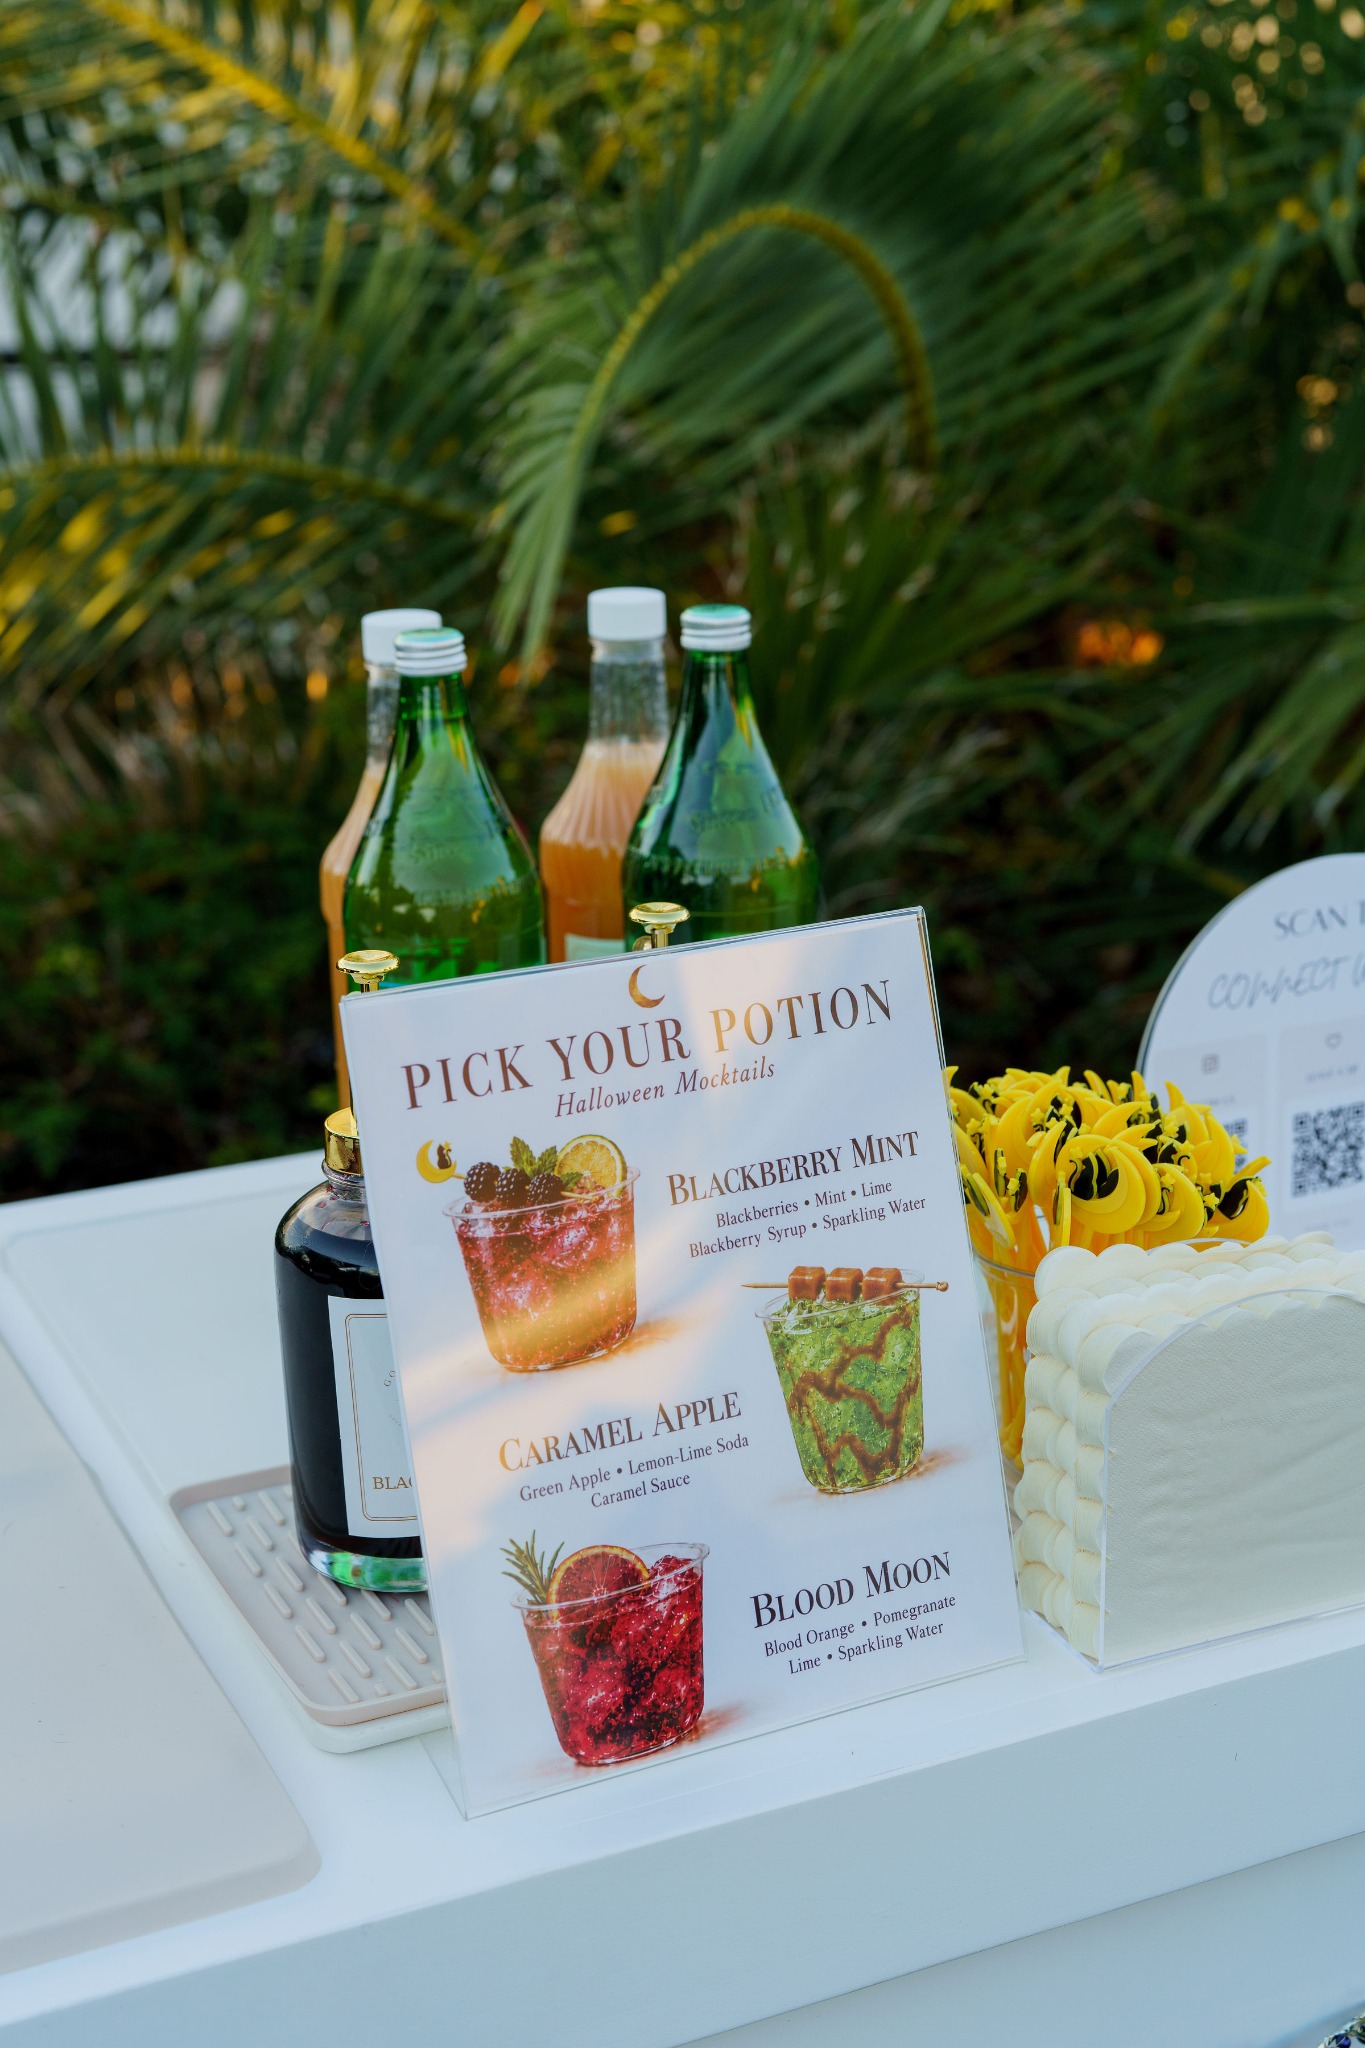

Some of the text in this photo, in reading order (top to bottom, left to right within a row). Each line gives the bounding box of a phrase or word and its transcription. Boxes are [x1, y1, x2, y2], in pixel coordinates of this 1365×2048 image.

[1273, 905, 1348, 941] SCAN
[401, 980, 891, 1109] PICK YOUR POTION
[556, 1058, 775, 1117] Halloween Mocktails
[666, 1131, 919, 1207] BLACKBERRY MINT
[689, 1197, 926, 1258] Blackberry Syrup Sparkling Water
[716, 1181, 892, 1228] Blackberries Mint Lime
[498, 1391, 742, 1472] CARAMEL APPLE
[519, 1433, 750, 1502] Green Apple Lemon-Lime Soda
[591, 1472, 691, 1508] Caramel Sauce
[750, 1551, 952, 1629] BLOOD MOON
[764, 1594, 957, 1658] Blood Orange Pomegranate
[788, 1621, 945, 1674] Lime Sparkling Water
